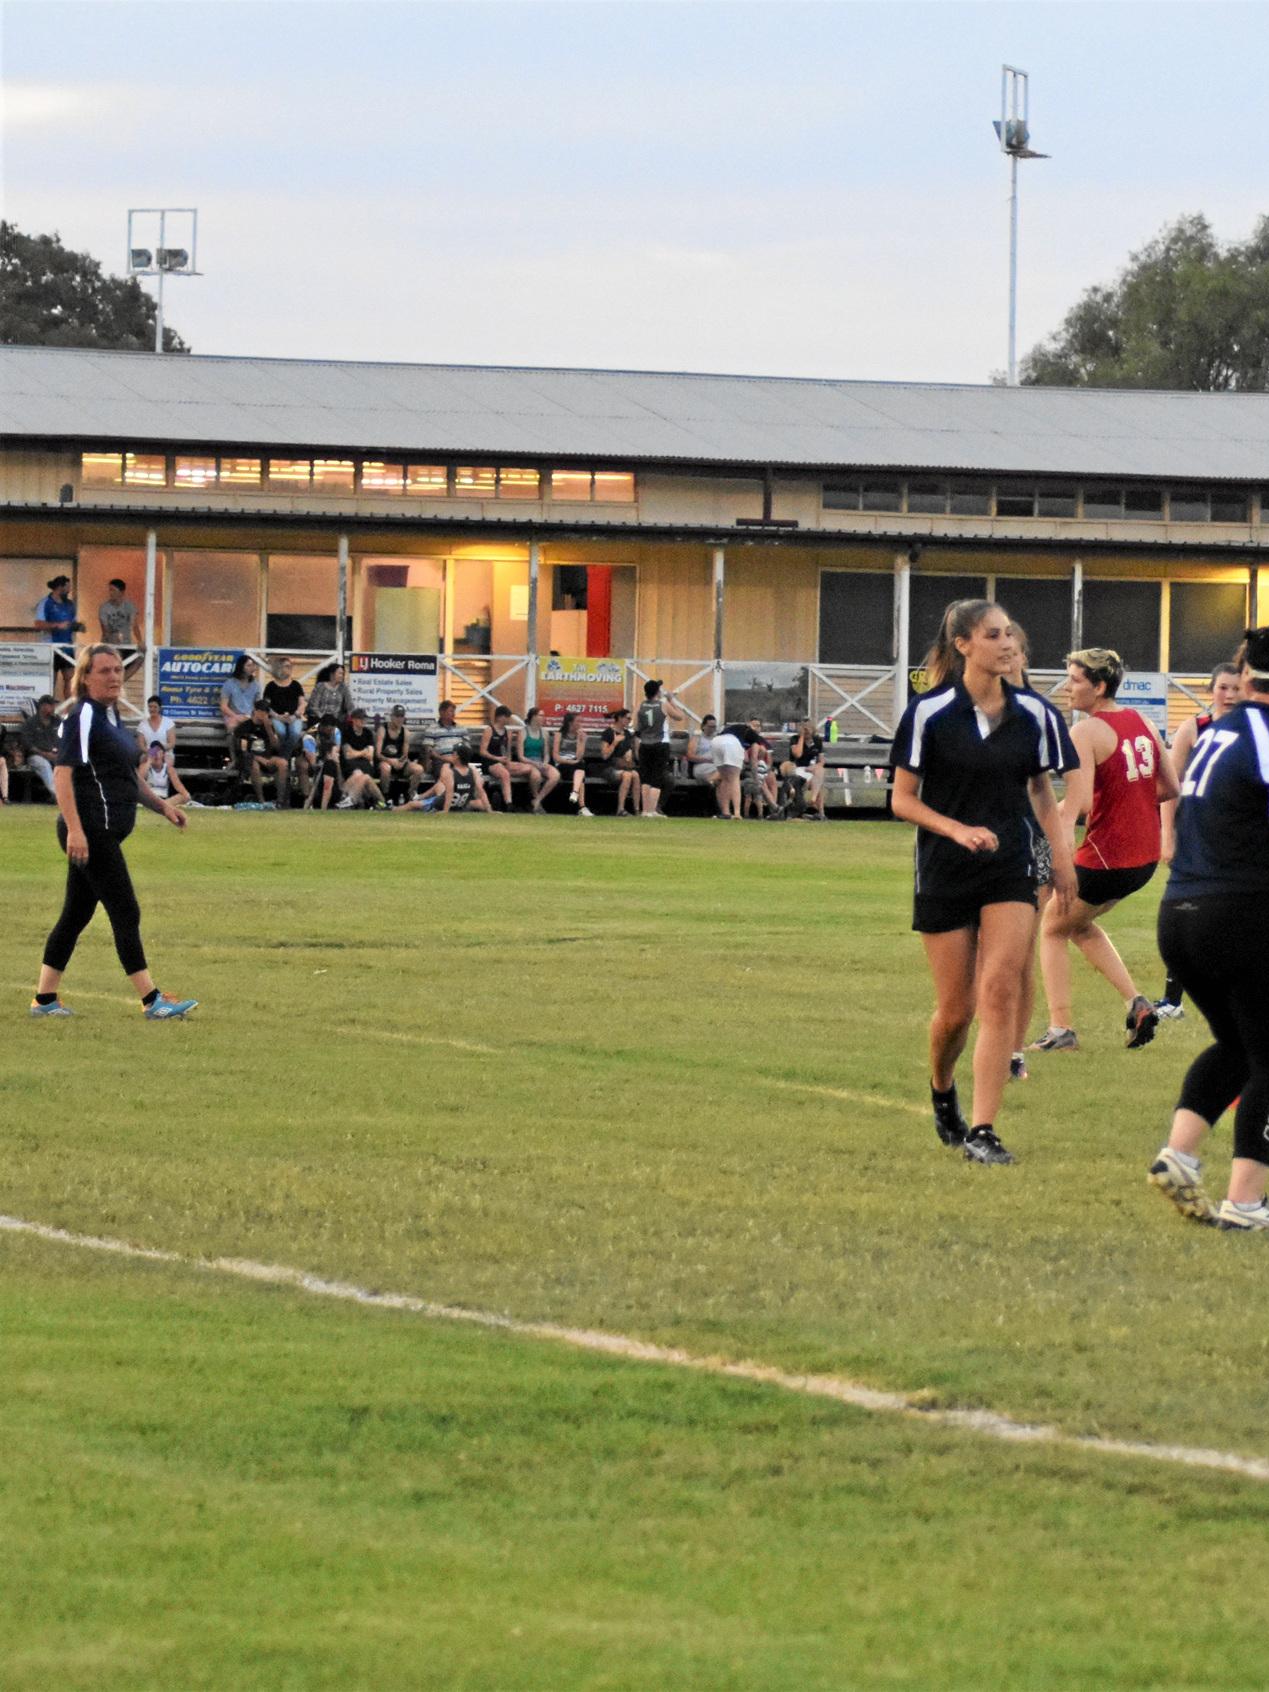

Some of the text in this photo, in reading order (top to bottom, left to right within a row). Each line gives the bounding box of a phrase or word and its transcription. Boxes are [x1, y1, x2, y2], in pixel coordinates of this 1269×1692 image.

[161, 661, 236, 673] AUTOCAR
[370, 658, 406, 669] Hooker
[407, 660, 435, 670] Roma
[541, 671, 622, 683] EARTHMOVING
[1123, 678, 1152, 690] dmac
[376, 687, 404, 697] Property
[405, 688, 423, 696] Sales
[386, 697, 427, 705] Management
[645, 709, 653, 727] 1
[1121, 735, 1154, 782] 13
[1180, 728, 1239, 798] 27
